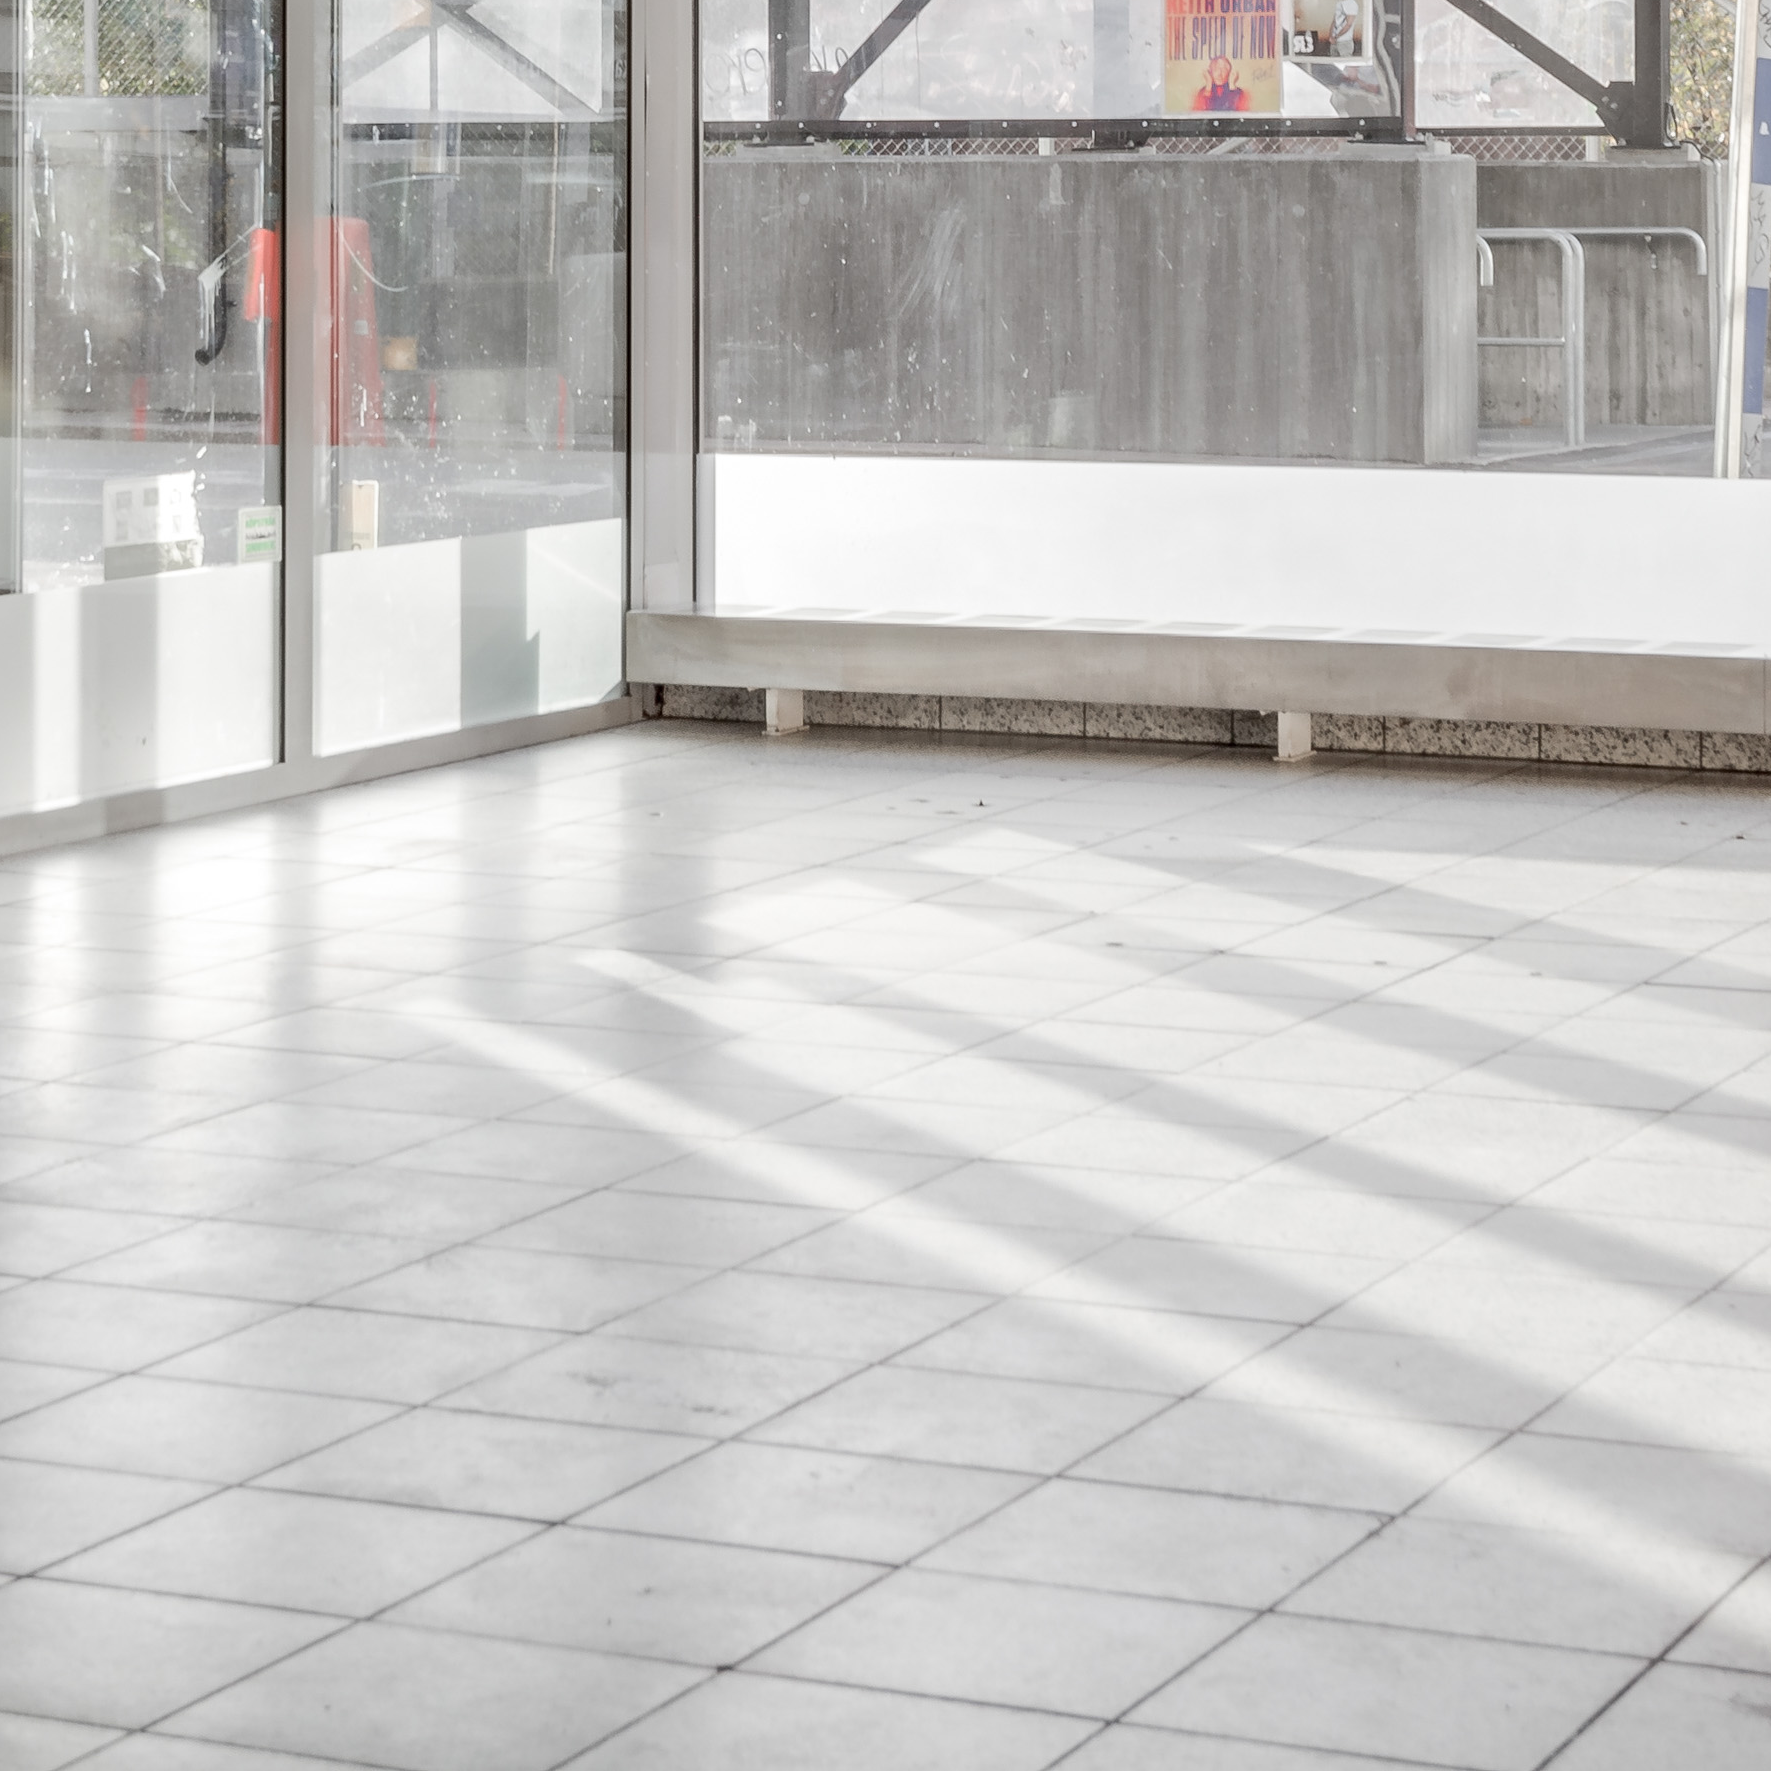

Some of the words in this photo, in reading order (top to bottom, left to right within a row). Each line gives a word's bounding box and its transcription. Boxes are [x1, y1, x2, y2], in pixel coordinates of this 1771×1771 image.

[1166, 16, 1186, 61] THE
[1191, 15, 1227, 61] SPEED
[1232, 16, 1245, 60] OF
[1250, 15, 1276, 59] NOW
